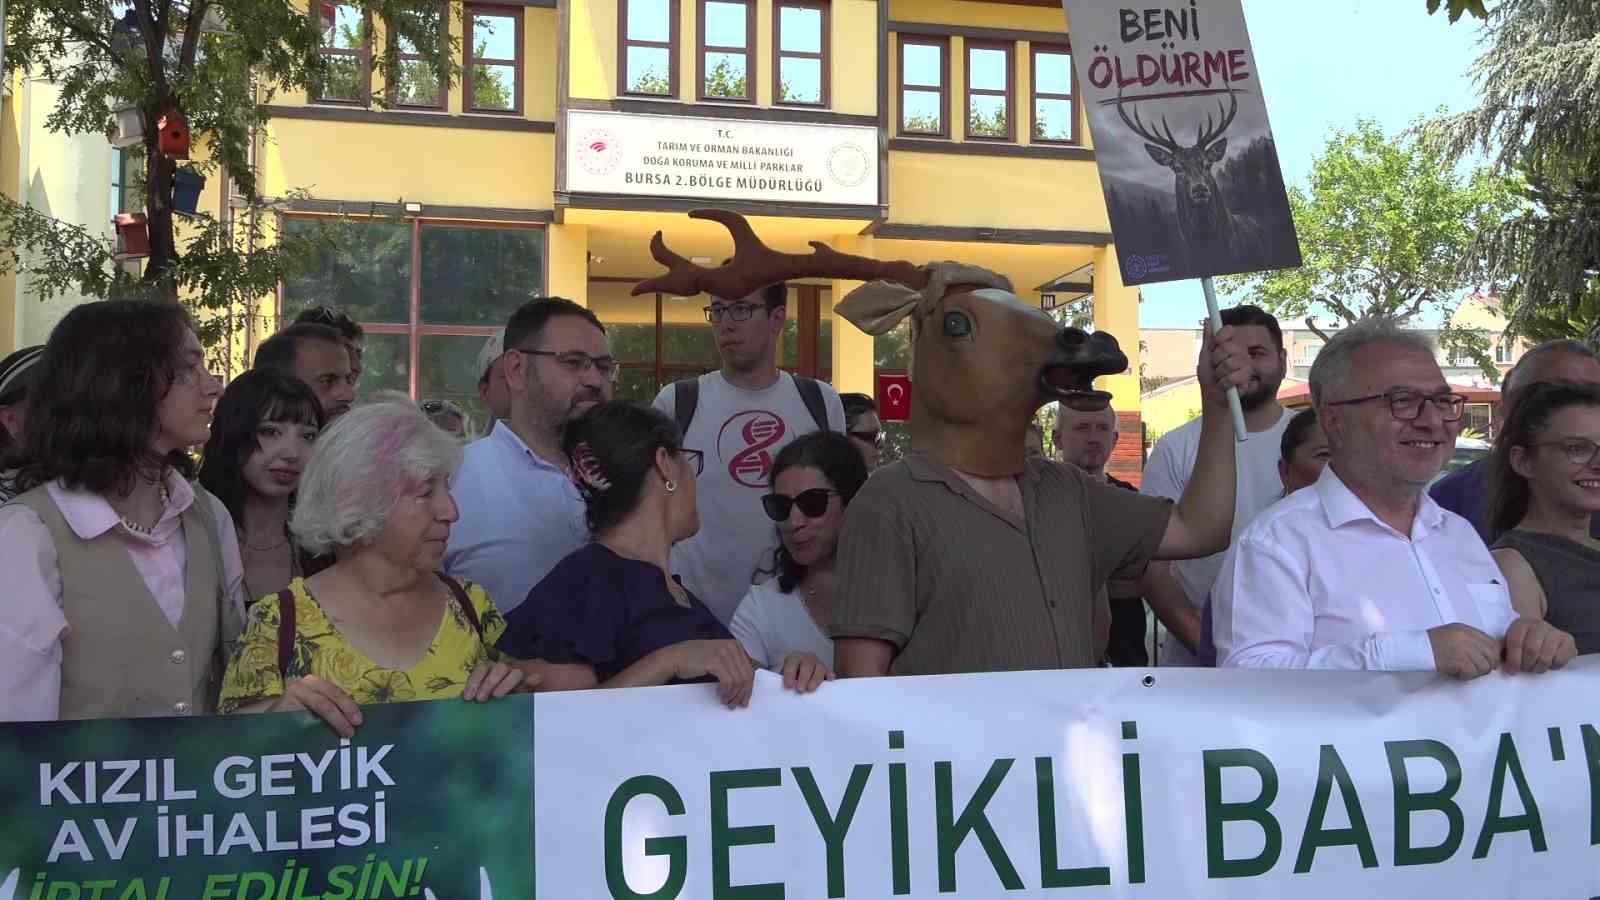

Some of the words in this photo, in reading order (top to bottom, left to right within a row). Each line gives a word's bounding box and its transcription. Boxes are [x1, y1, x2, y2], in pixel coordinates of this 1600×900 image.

[1118, 0, 1200, 43] BENİ
[1088, 42, 1250, 89] ÖLDÜRME
[657, 141, 688, 151] TARIM
[690, 143, 702, 153] VE
[703, 144, 739, 154] ORMAN
[742, 145, 794, 157] BAKANLIĞI
[717, 129, 734, 139] T.C.
[625, 172, 671, 185] BURSA
[736, 175, 823, 192] MÜDÜRLÜĞÜ
[643, 155, 670, 166] DOĞA
[672, 158, 714, 168] KORUMA
[716, 160, 729, 169] VE
[730, 160, 757, 170] MİLLİ
[760, 162, 804, 172] PARKLAR
[39, 758, 197, 806] KIZIL
[213, 737, 397, 799] GEYİK
[46, 817, 138, 864] AV
[157, 790, 386, 858] İHALESİ
[603, 721, 1148, 900] GEYİKLİ
[202, 853, 429, 900] EDİLSİN!
